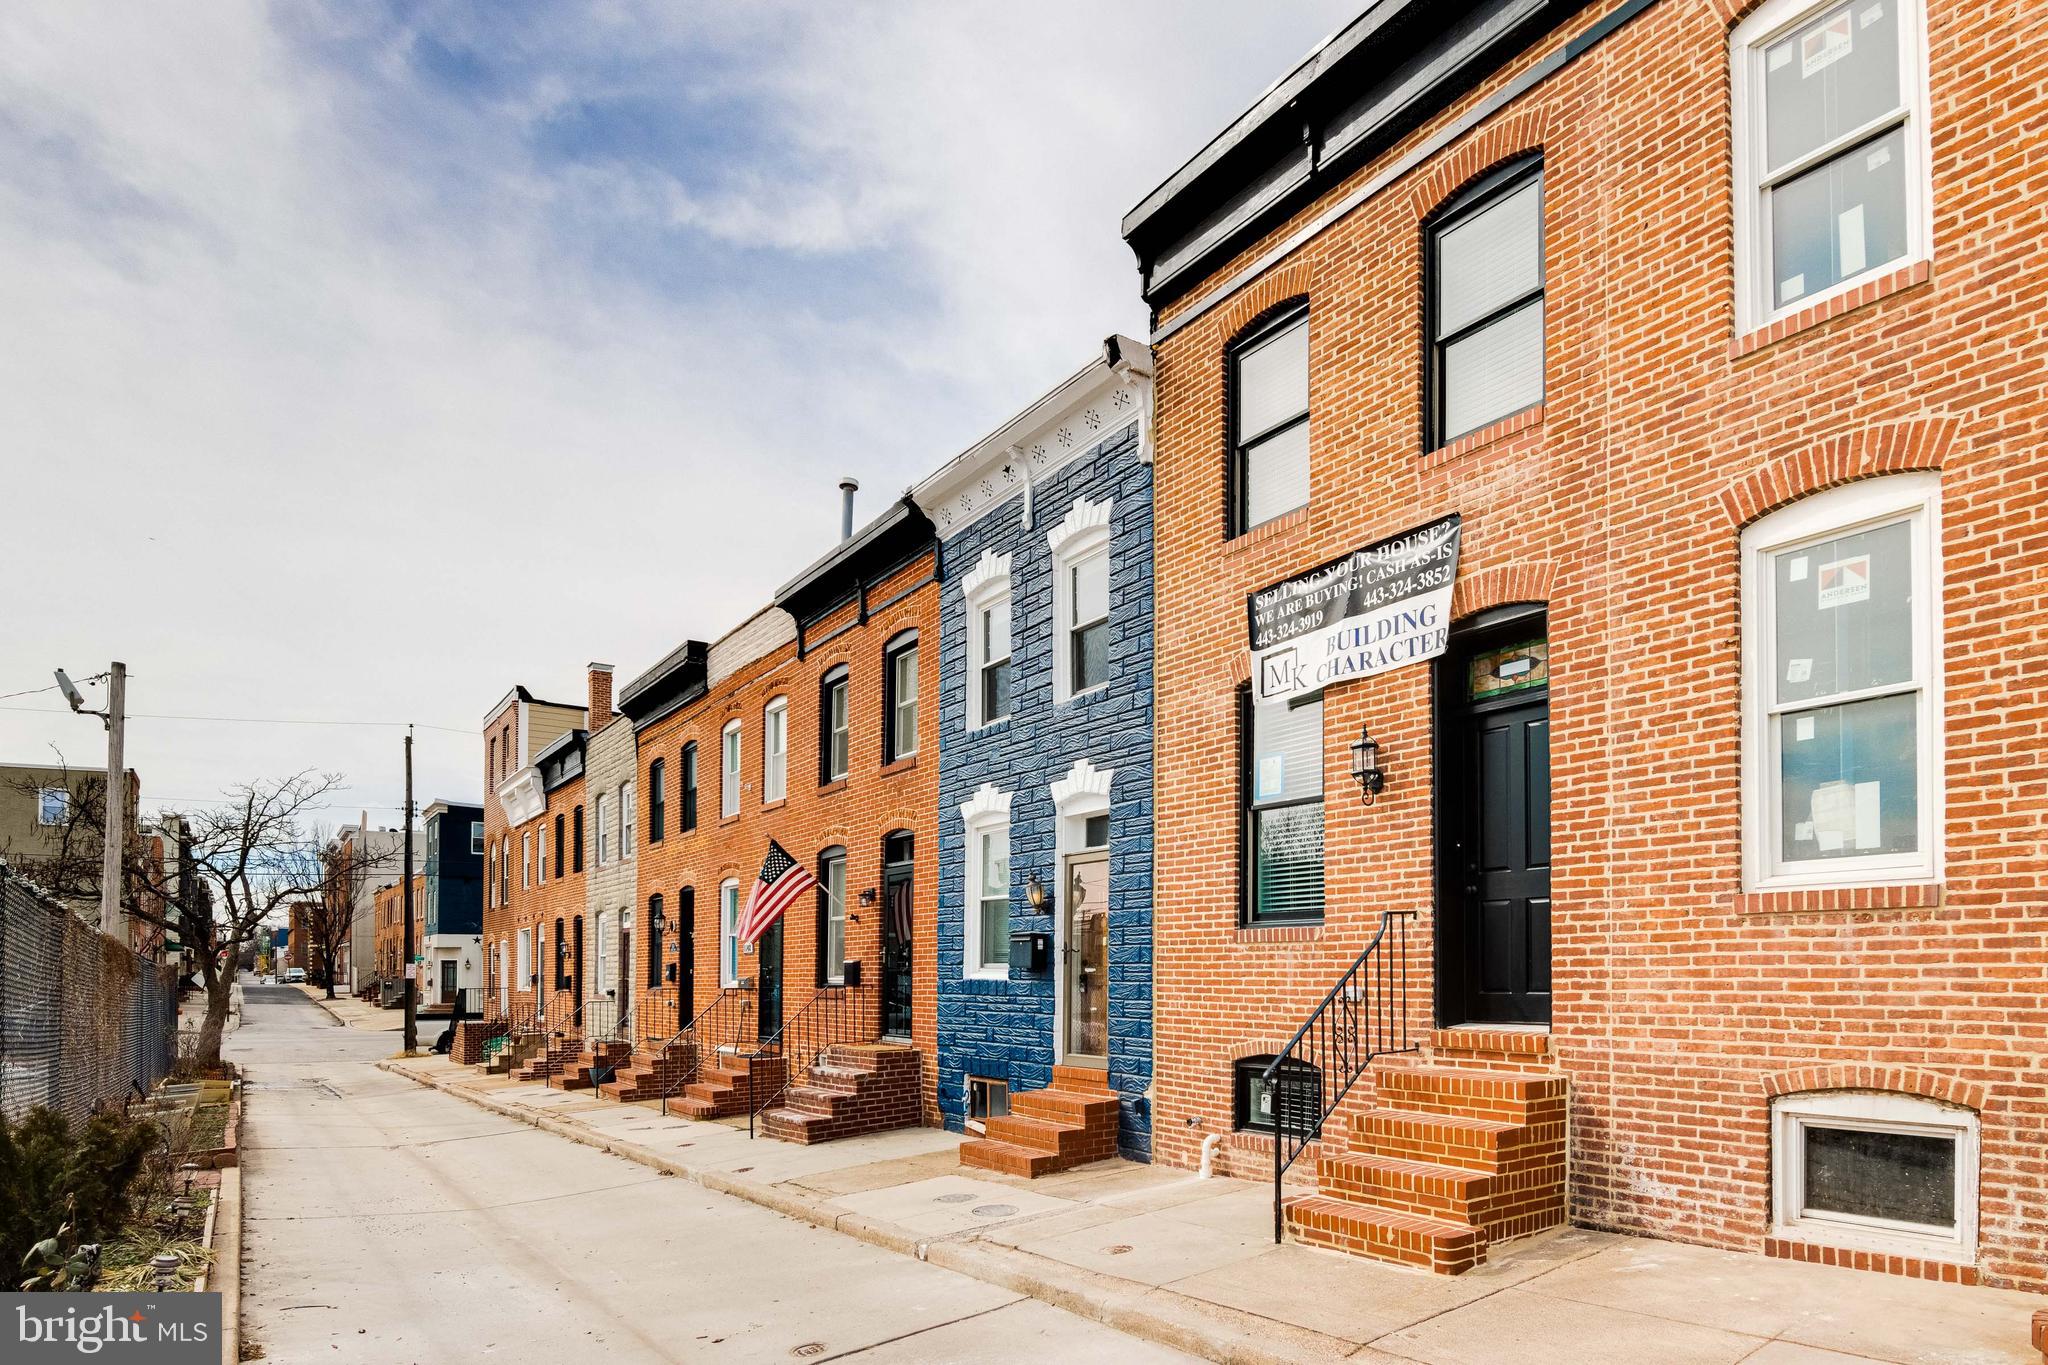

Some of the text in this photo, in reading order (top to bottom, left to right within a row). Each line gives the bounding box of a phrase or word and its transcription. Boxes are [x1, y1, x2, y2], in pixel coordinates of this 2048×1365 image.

[1255, 521, 1451, 611] SELLING YOUR HOUSE?
[1255, 541, 1453, 627] WE ARE BUYING! CASH AS-IS
[1363, 564, 1451, 608] 443-324-3852
[1821, 583, 1867, 600] ANDERSEN
[1255, 610, 1324, 647] 443-324-3919
[1326, 604, 1437, 656] BUILDING
[1316, 627, 1447, 683] CHARACTER
